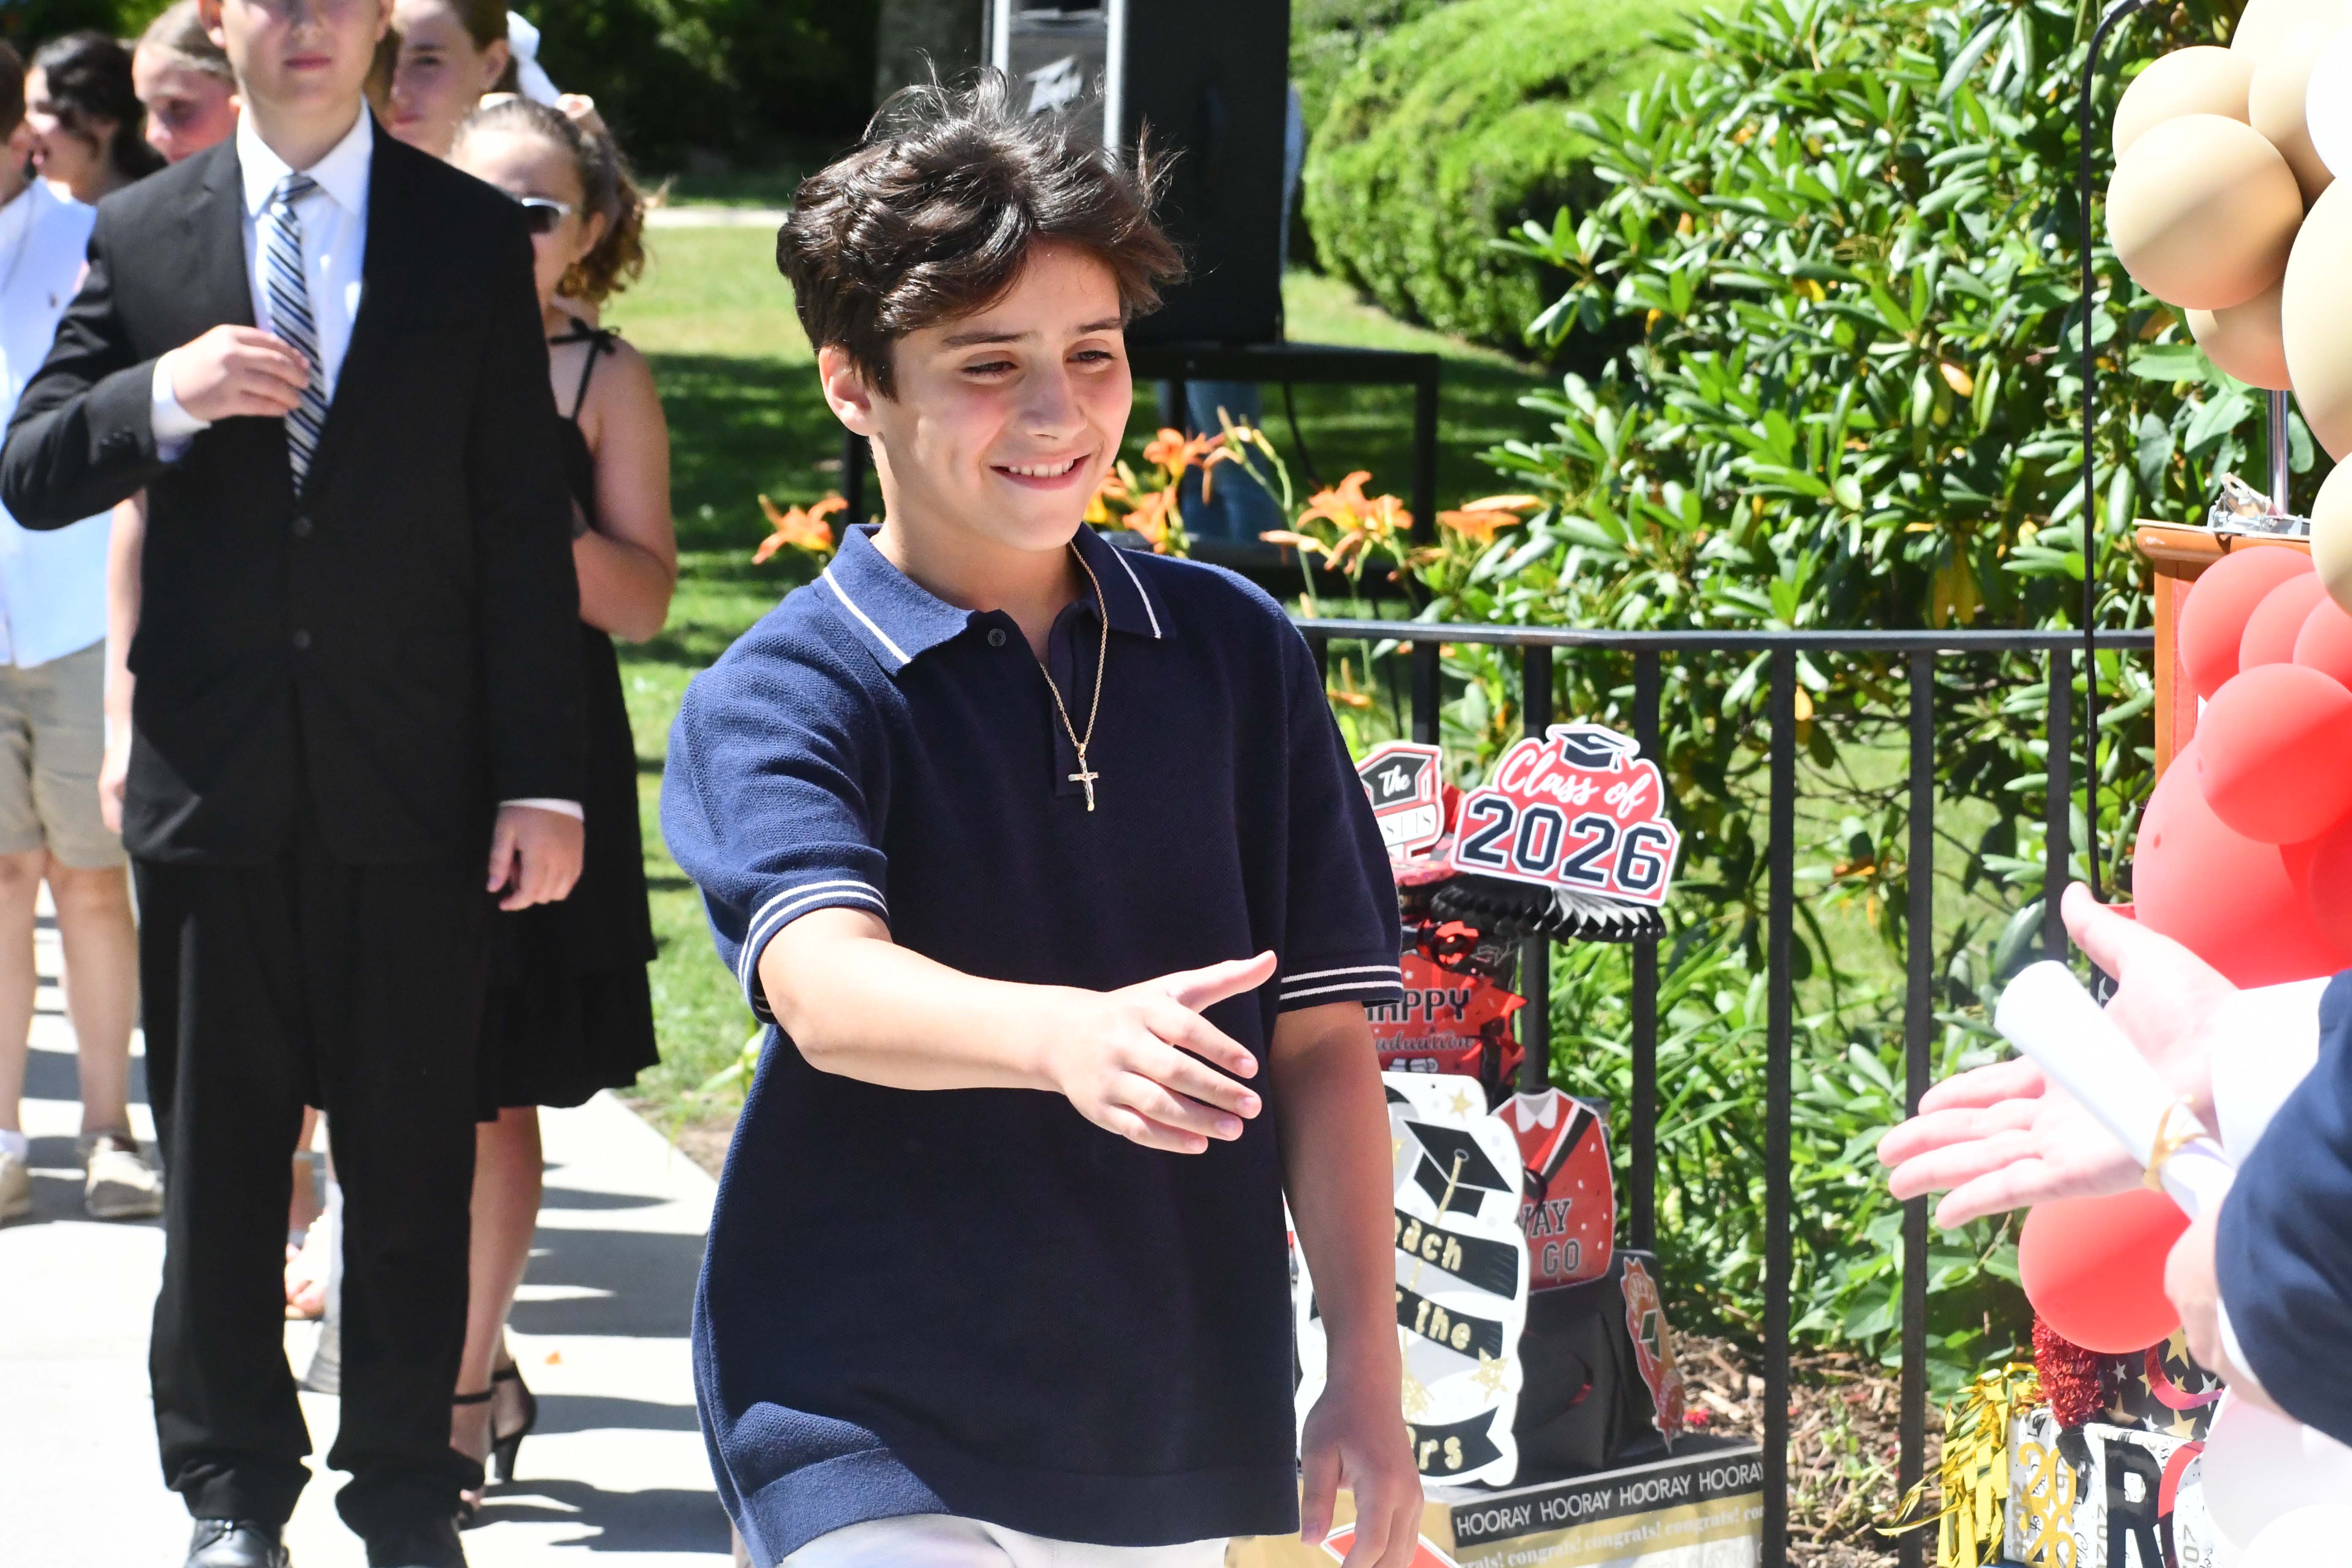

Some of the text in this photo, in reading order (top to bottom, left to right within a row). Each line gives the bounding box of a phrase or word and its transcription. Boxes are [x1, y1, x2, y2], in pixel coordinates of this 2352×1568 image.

[1378, 765, 1411, 797] The
[1501, 749, 1652, 819] Class of
[1459, 792, 1671, 896] 2026
[1375, 1029, 1475, 1052] aduation
[1542, 1238, 1581, 1277] GO
[1416, 1299, 1471, 1350] the
[1456, 1503, 1531, 1537] HOORAY
[1540, 1489, 1612, 1522] HOORAY
[1620, 1474, 1691, 1507] HOORAY
[1507, 1535, 1582, 1567] congrats!
[1585, 1521, 1661, 1550] congrats!
